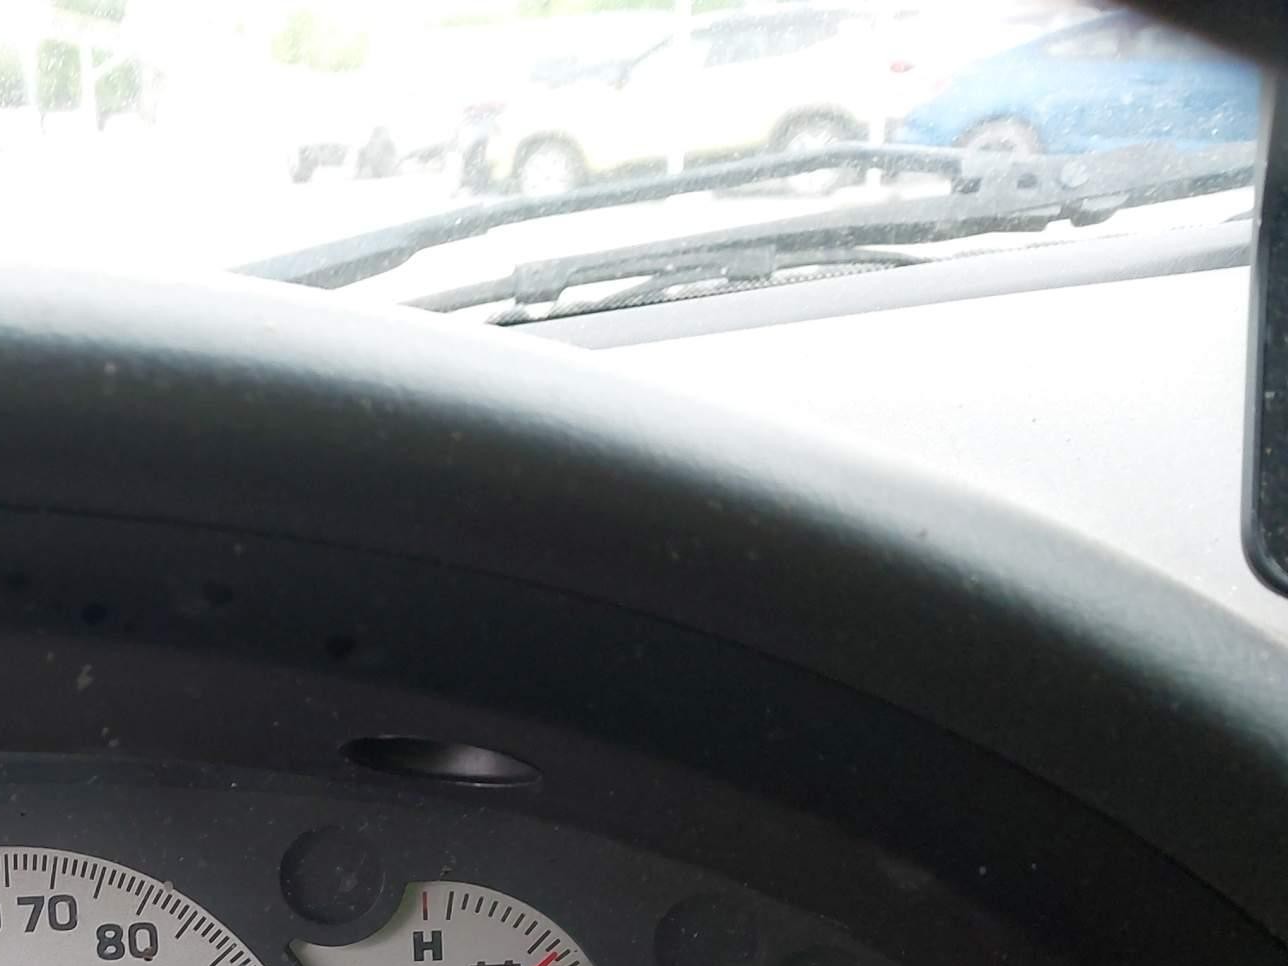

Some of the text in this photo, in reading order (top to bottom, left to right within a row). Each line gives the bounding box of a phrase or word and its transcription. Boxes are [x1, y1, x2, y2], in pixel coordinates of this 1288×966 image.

[17, 895, 78, 932] 70
[96, 922, 158, 960] 80
[413, 931, 442, 962] H
